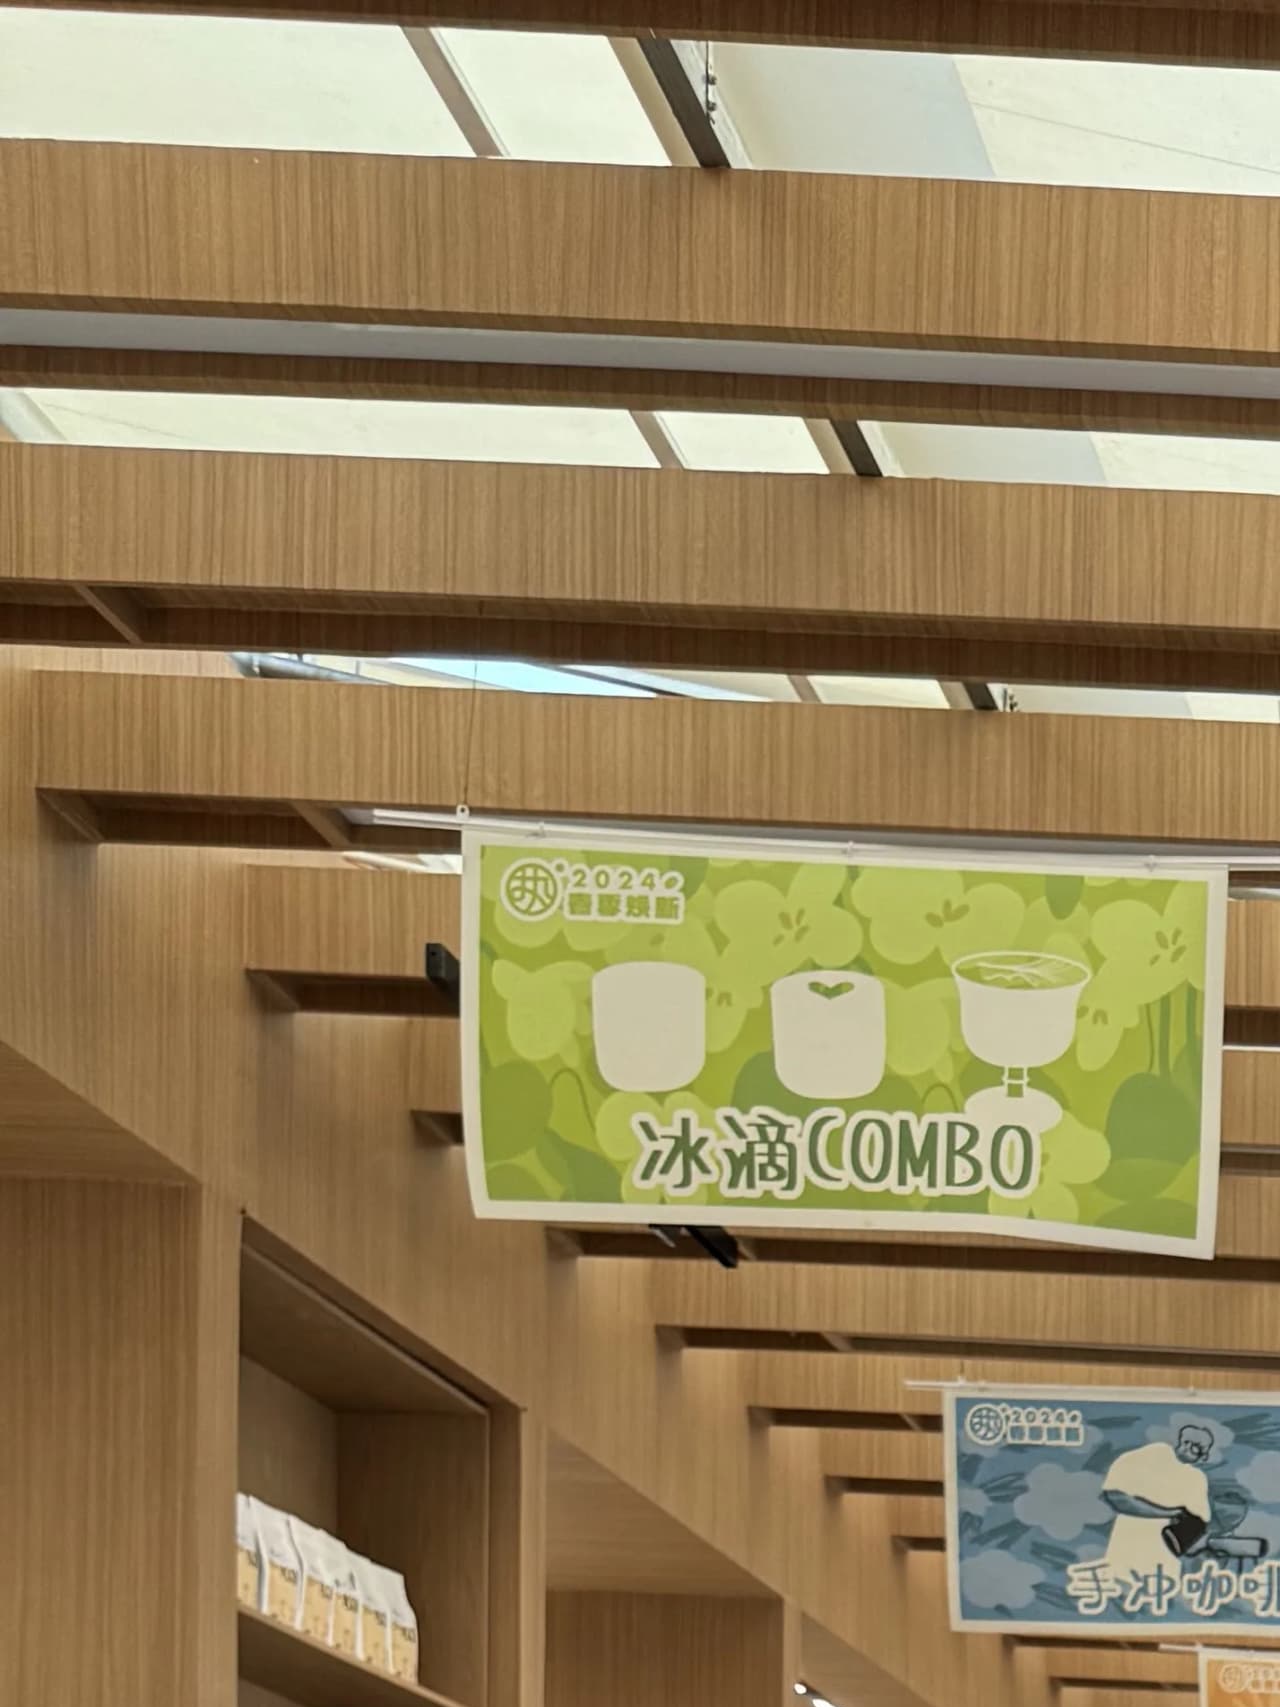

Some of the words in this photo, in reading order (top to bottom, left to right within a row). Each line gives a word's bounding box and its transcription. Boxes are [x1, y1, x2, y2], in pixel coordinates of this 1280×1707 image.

[571, 868, 657, 890] 2024
[638, 1111, 1036, 1195] 冰滴COMBO
[1011, 1410, 1066, 1424] 2024
